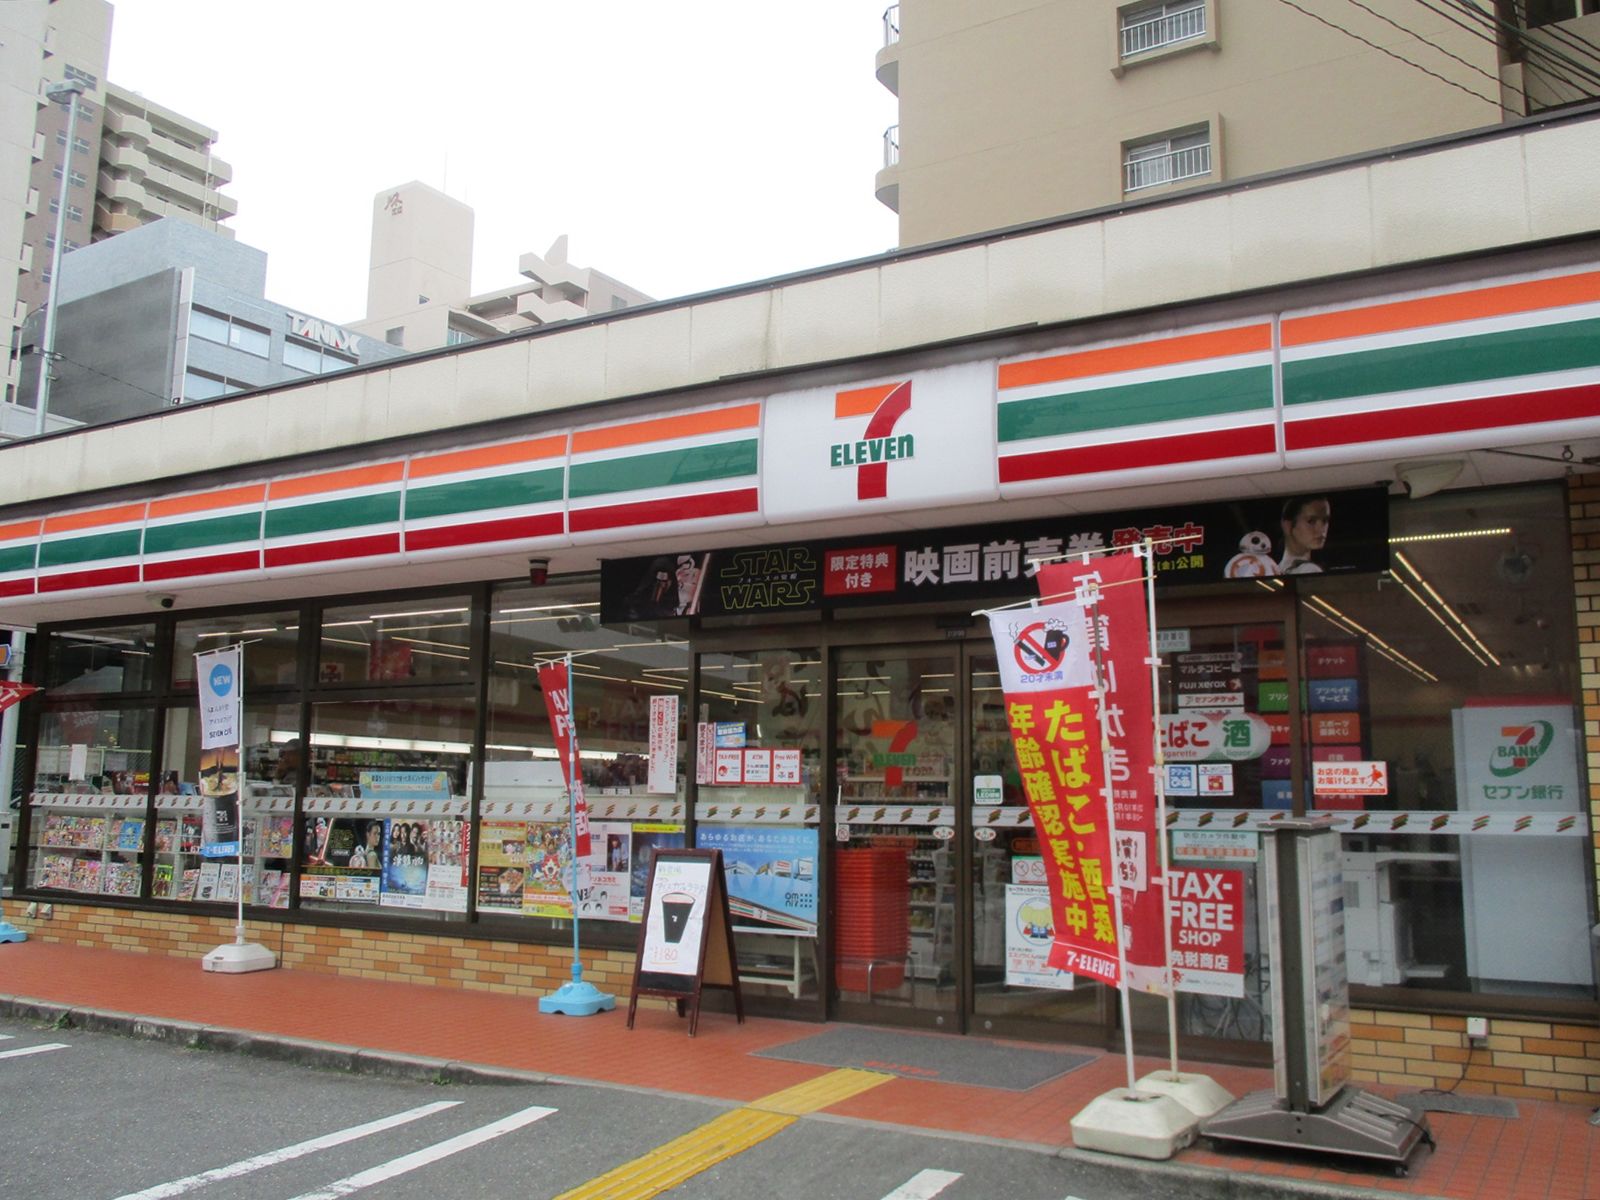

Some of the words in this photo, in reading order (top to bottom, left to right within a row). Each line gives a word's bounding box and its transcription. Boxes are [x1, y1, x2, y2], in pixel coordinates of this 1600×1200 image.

[286, 312, 361, 357] TANAX
[721, 547, 816, 577] STAR
[831, 552, 889, 572] 限定特典
[845, 573, 873, 589] 付き
[721, 579, 816, 609] WARS
[1319, 657, 1345, 665] チケット
[213, 675, 231, 686] NEW
[1020, 671, 1063, 684] 20才未満
[1179, 681, 1197, 690] FUJI
[1268, 693, 1289, 702] プリン
[1319, 694, 1349, 702] サービス
[1319, 720, 1350, 728] スポーツ
[1222, 719, 1250, 748] 酒
[1498, 746, 1538, 758] BANK
[1317, 768, 1359, 776] お店の商品
[1483, 785, 1563, 800] セブン銀行
[1008, 703, 1087, 936] 年齢確認実施中
[1169, 900, 1235, 931] FREE
[1178, 930, 1222, 947] SHOP
[1171, 949, 1229, 971] 免税商店
